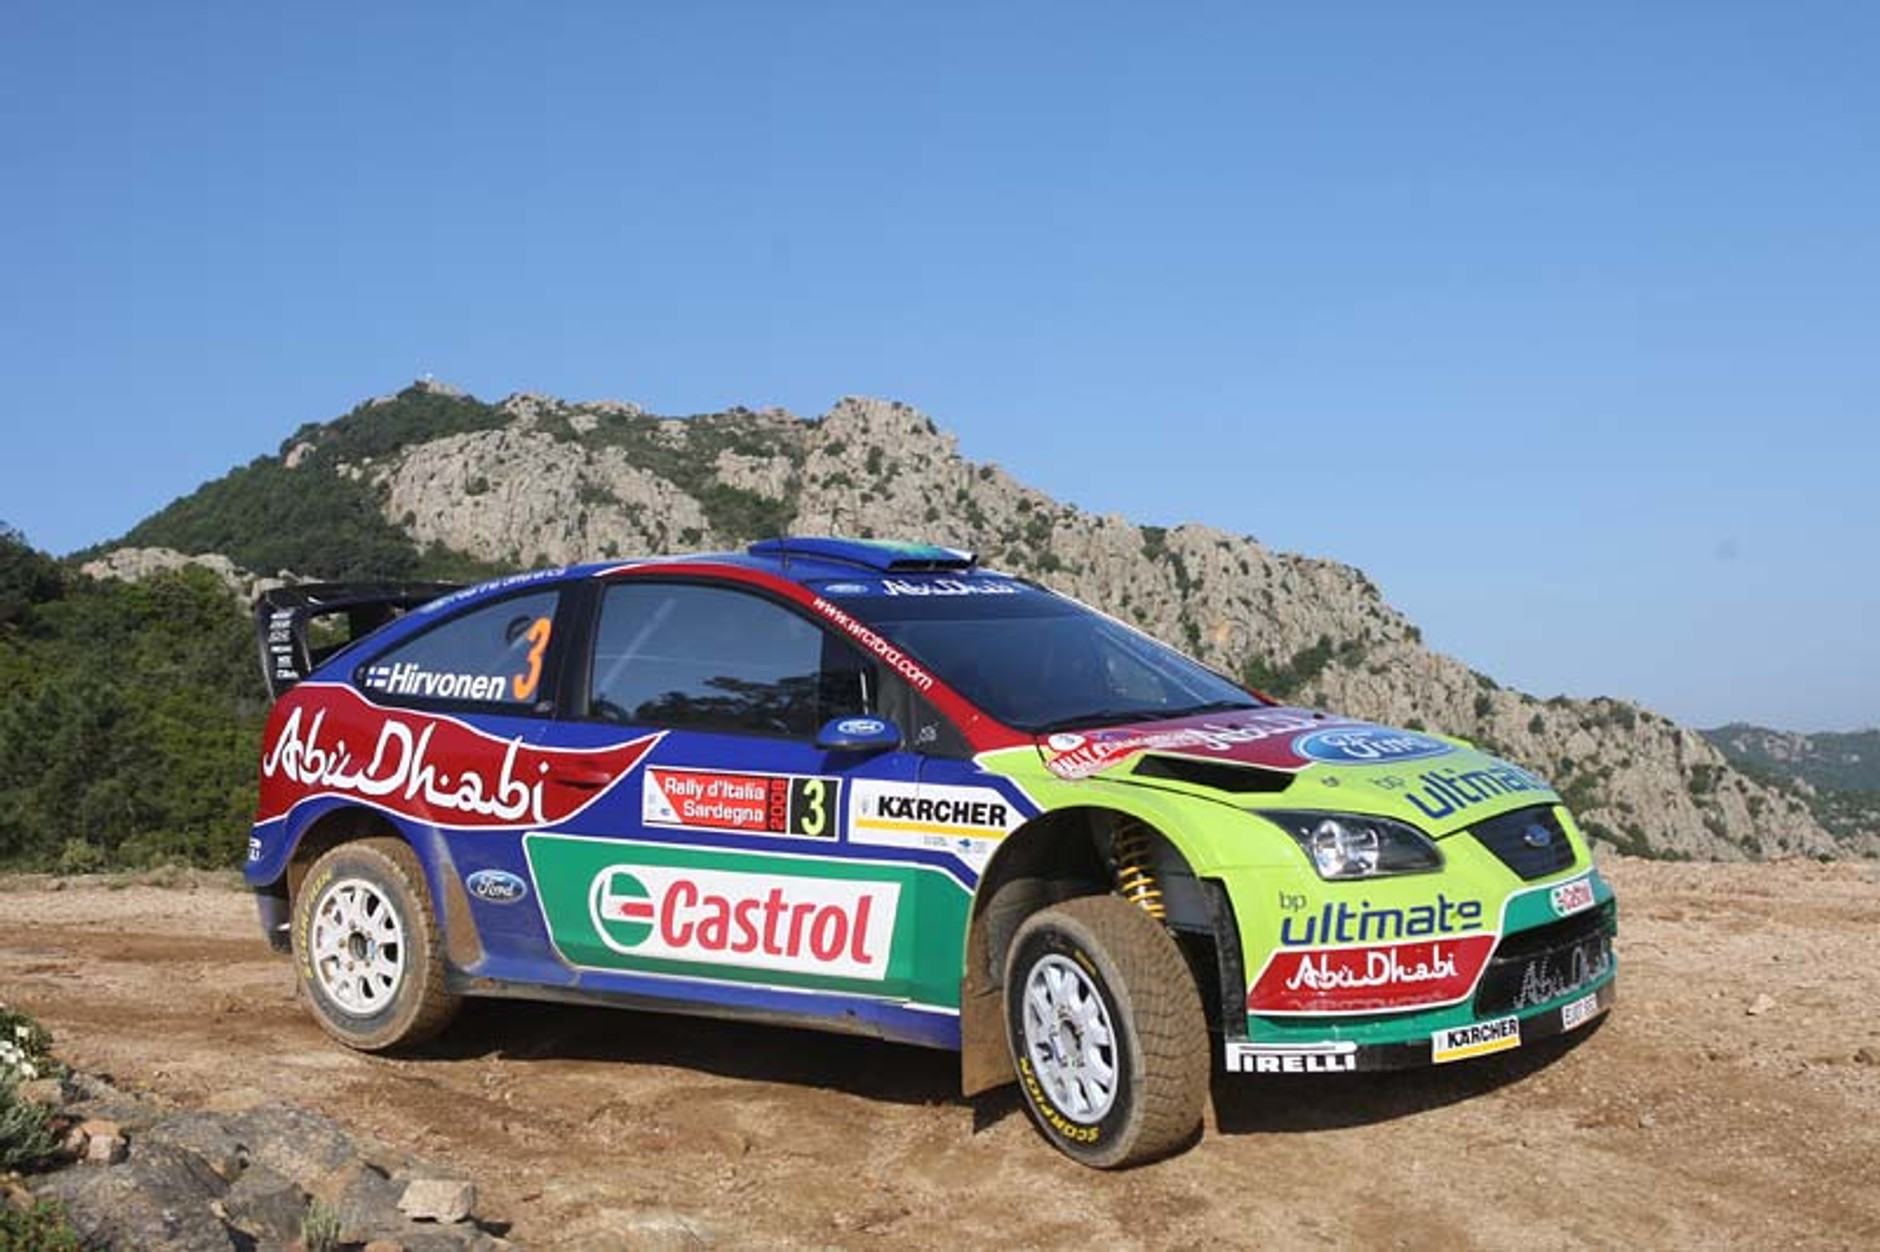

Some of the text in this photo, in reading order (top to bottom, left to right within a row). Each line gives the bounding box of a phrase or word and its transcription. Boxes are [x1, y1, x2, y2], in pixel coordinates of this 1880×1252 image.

[512, 617, 552, 699] 3
[386, 662, 507, 699] Hirvonen
[263, 706, 550, 826] Abu Dhabi
[664, 777, 765, 800] Rally d'Italia
[800, 778, 827, 836] 3
[683, 800, 764, 825] Sardegna
[877, 795, 1008, 827] KÄRCHER
[660, 878, 874, 965] Castrol
[1279, 891, 1308, 913] bp
[1280, 893, 1483, 946] ultimate
[1286, 944, 1459, 991] Abu Dhabi
[1224, 1042, 1358, 1073] PIRELLI
